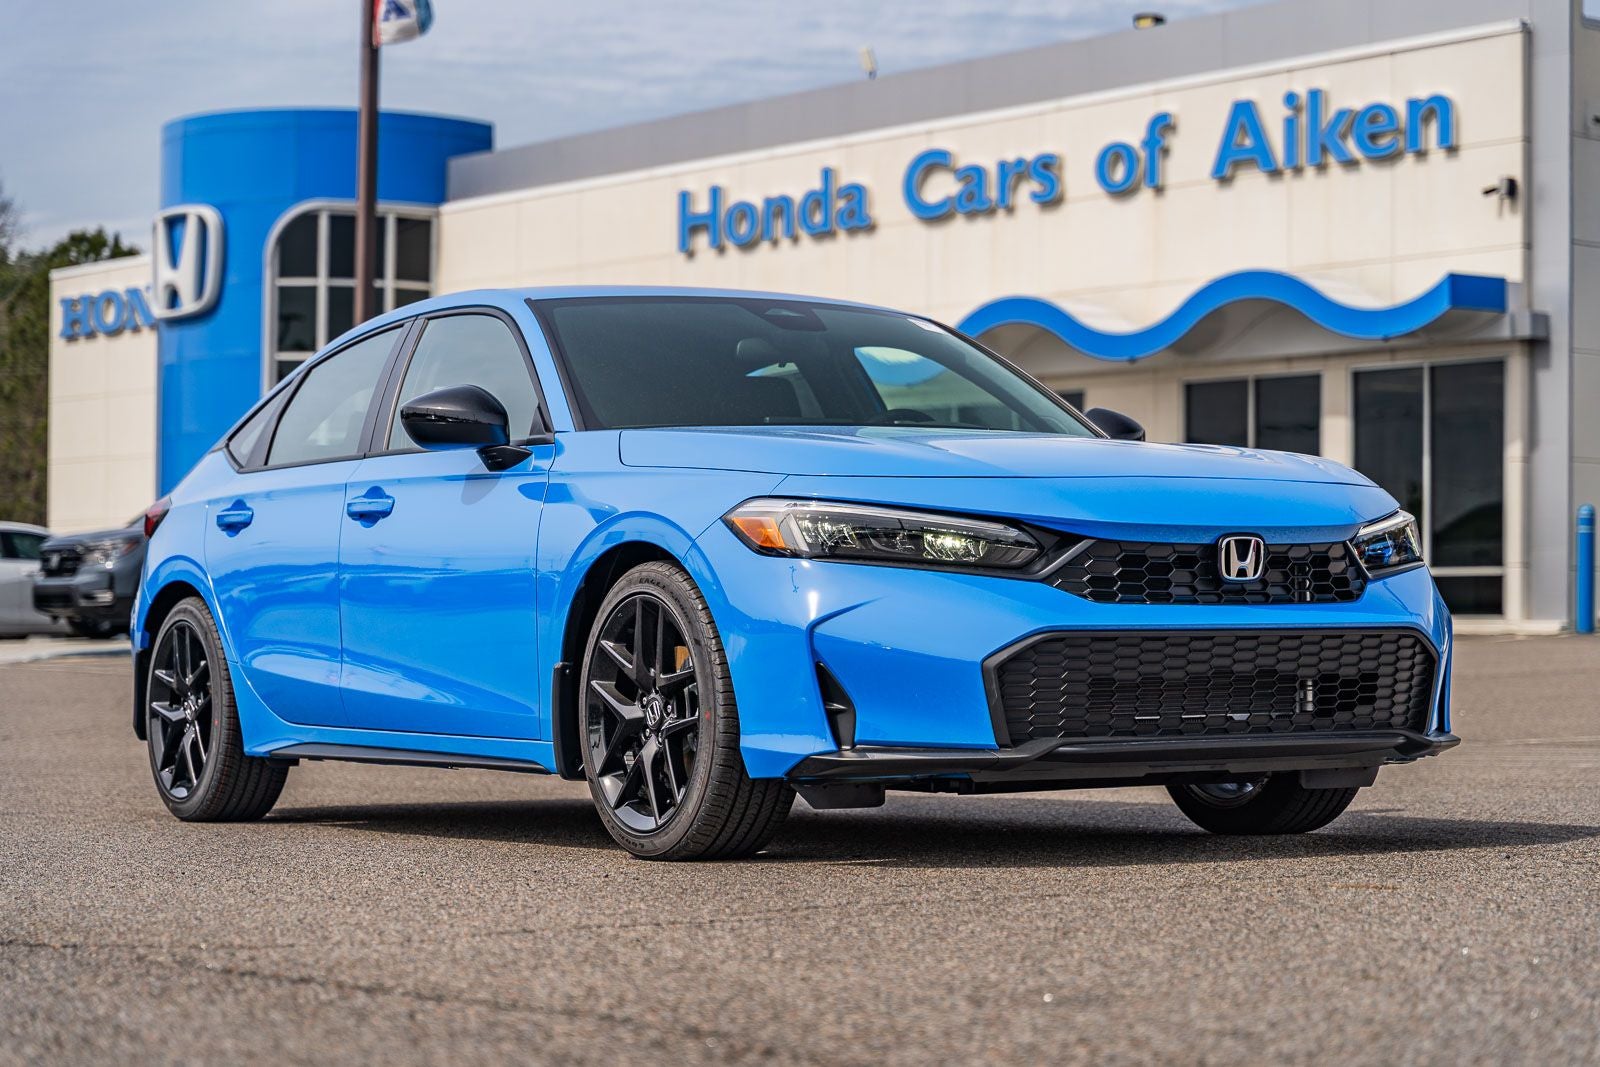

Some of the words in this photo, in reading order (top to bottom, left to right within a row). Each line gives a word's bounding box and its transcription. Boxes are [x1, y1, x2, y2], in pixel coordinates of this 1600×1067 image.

[679, 168, 870, 251] Honda
[903, 149, 1058, 219] Cars
[1096, 113, 1171, 192] of
[1212, 89, 1452, 178] Aiken
